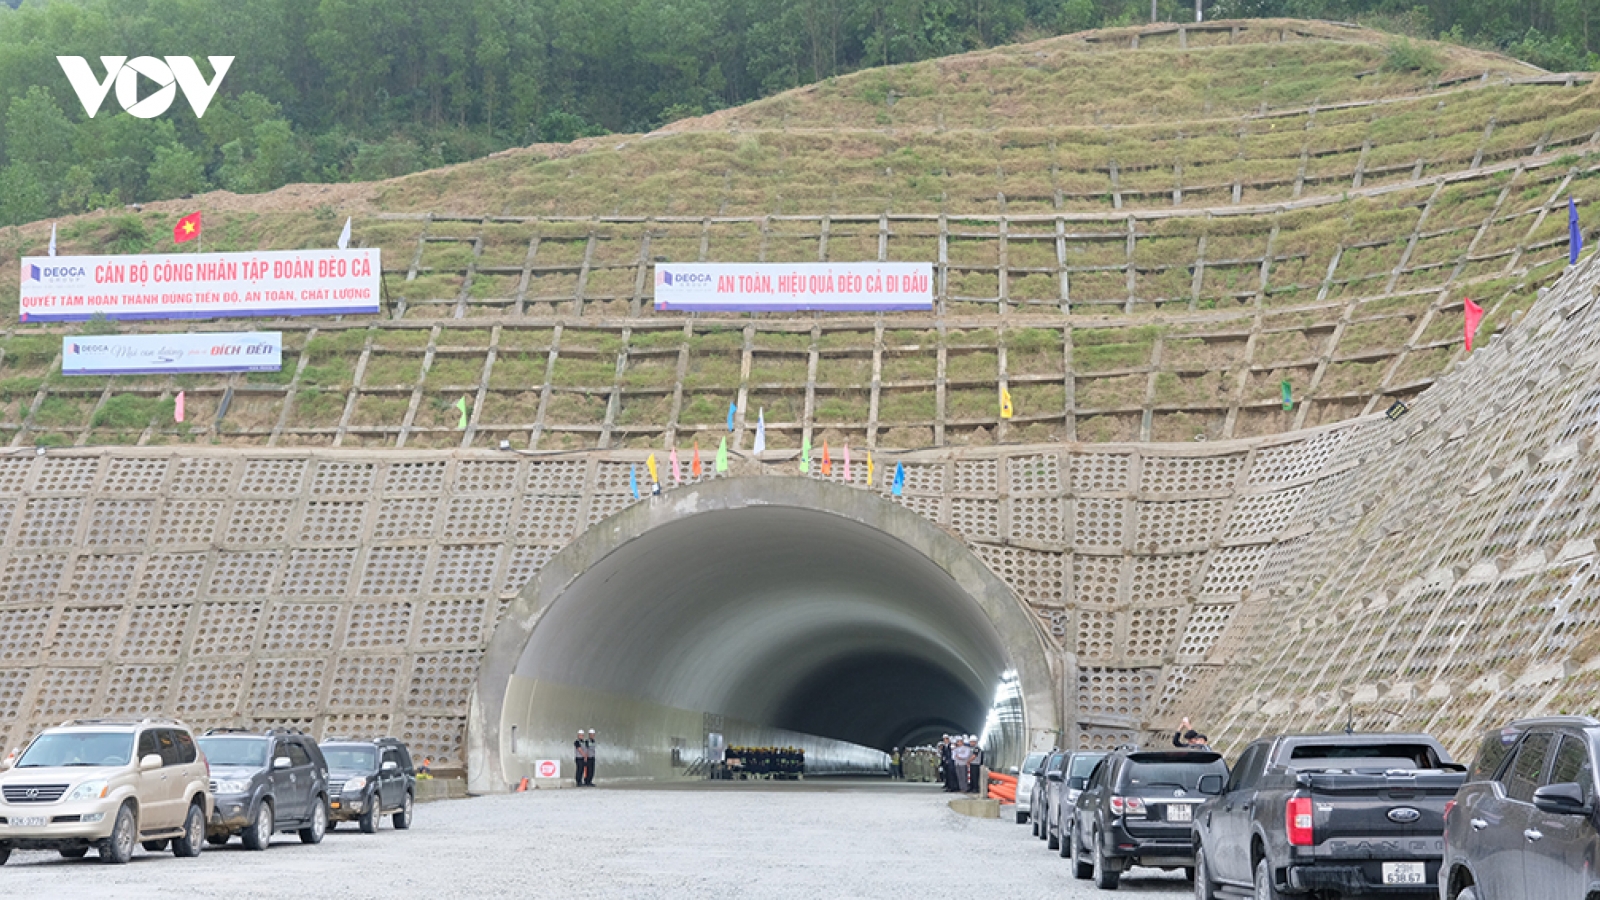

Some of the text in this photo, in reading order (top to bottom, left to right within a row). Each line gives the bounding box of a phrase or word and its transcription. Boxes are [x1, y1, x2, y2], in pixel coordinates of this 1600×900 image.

[44, 266, 86, 277] DEOCA
[95, 251, 371, 287] CÁN BỘ CÔNG NHÂN TẬP ĐOÀN ĐÈO CẢ
[675, 273, 712, 282] DEOCA
[717, 275, 735, 293] AN
[738, 271, 775, 295] TOÀN,
[778, 271, 806, 297] HIỆU
[809, 268, 835, 295] QUẢ
[838, 271, 863, 293] ĐÈO
[866, 268, 883, 293] CẢ
[886, 275, 899, 293] ĐI
[22, 293, 57, 307] QUYẾT
[60, 293, 84, 306] TÂM
[87, 293, 118, 306] HOÀN
[122, 292, 159, 305] THÀNH
[161, 291, 193, 304] ĐÚNG
[195, 289, 220, 303] TIẾN
[244, 291, 261, 302] AN
[301, 286, 330, 301] CHẤT
[333, 286, 371, 301] LƯỢNG
